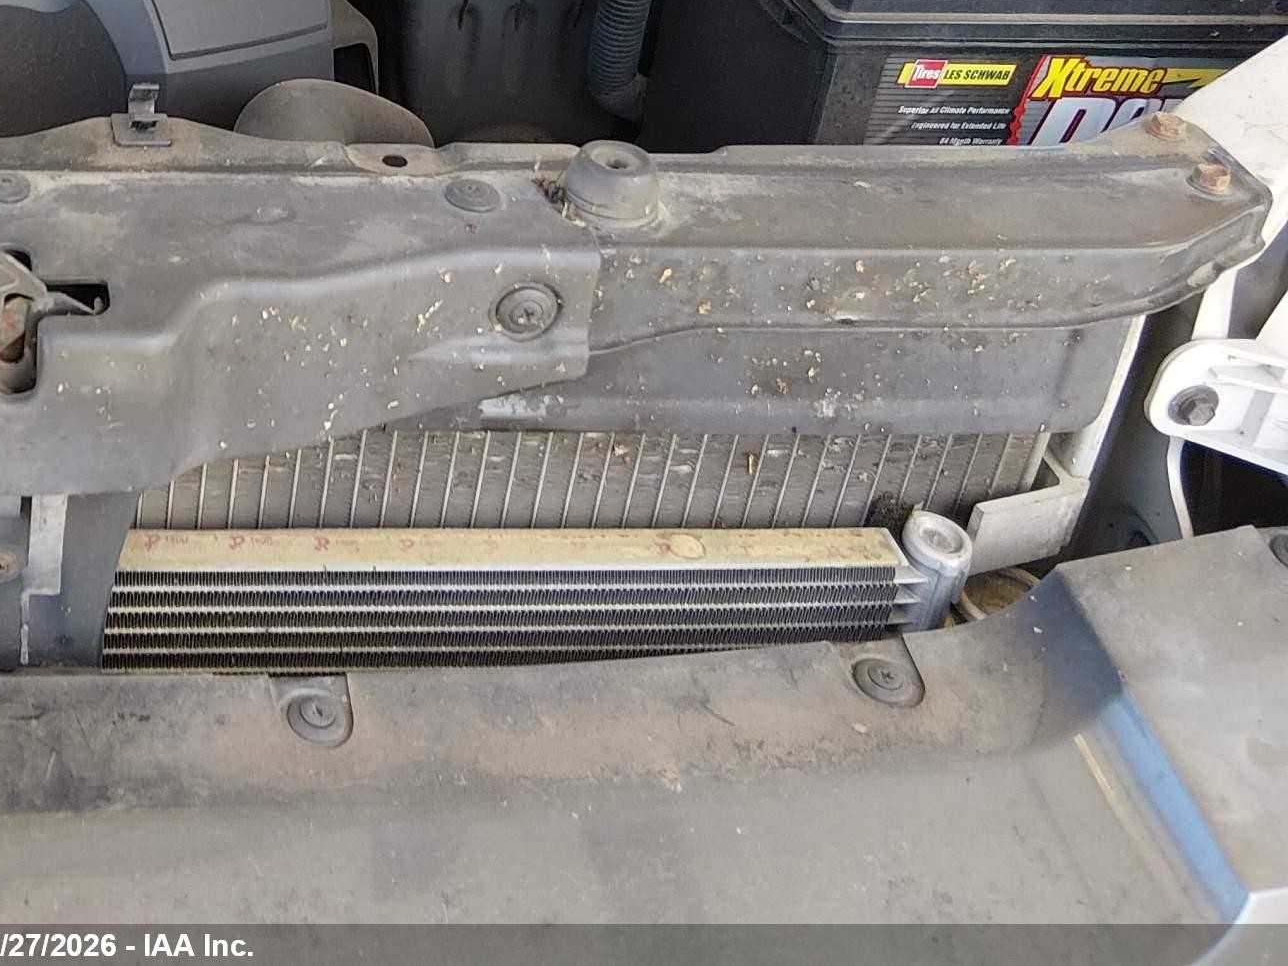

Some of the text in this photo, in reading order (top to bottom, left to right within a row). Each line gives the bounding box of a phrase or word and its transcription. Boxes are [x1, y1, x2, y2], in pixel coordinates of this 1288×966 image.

[912, 64, 1011, 81] Tires LES SCHWAB
[1031, 57, 1166, 99] Xtreme
[898, 105, 929, 114] Superior
[939, 105, 967, 114] Climate
[967, 106, 1011, 114] Performance
[911, 121, 950, 130] Engineered
[950, 121, 960, 129] for
[961, 121, 993, 130] Extended
[972, 137, 1004, 146] Warranty
